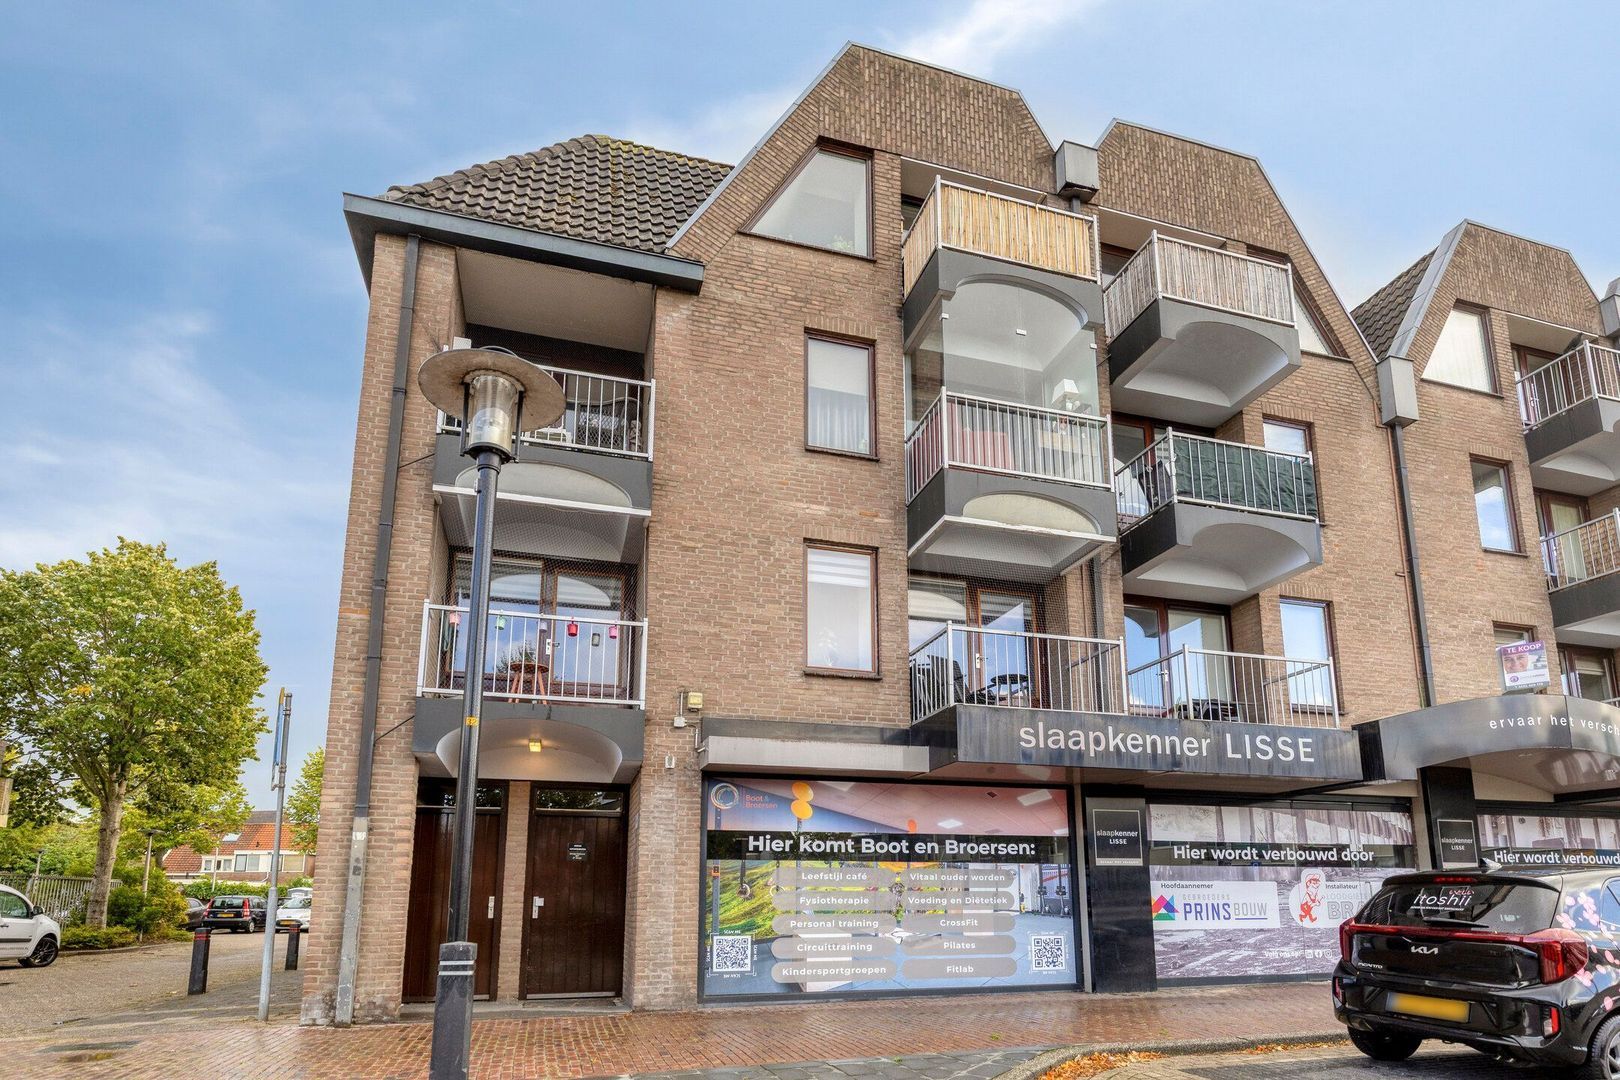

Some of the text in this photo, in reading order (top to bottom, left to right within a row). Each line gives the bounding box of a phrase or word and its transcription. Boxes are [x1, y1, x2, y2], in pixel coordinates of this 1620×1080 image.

[1518, 643, 1542, 652] KOOP
[1489, 716, 1542, 729] ervaar
[1550, 714, 1574, 727] het
[1019, 721, 1315, 762] slaapkenner LISSE
[1096, 829, 1139, 838] slaapkenner
[748, 835, 1036, 855] Hier komt Boot en Broersen:
[1173, 845, 1375, 862] Hier wordt verbouwd door
[1494, 850, 1520, 863] Hier
[1523, 851, 1560, 864] wordt
[802, 872, 867, 881] Leefstijl café
[800, 897, 870, 905] Fysiotherapie
[908, 896, 947, 905] Voeding
[1182, 893, 1231, 901] GEBROEDERS
[790, 919, 879, 928] Personal training
[939, 919, 978, 927] CrossFit
[796, 943, 873, 952] Circuittraining
[943, 941, 976, 949] Pilates
[782, 966, 887, 976] Kindersportgroepen
[946, 965, 974, 973] Fitlab
